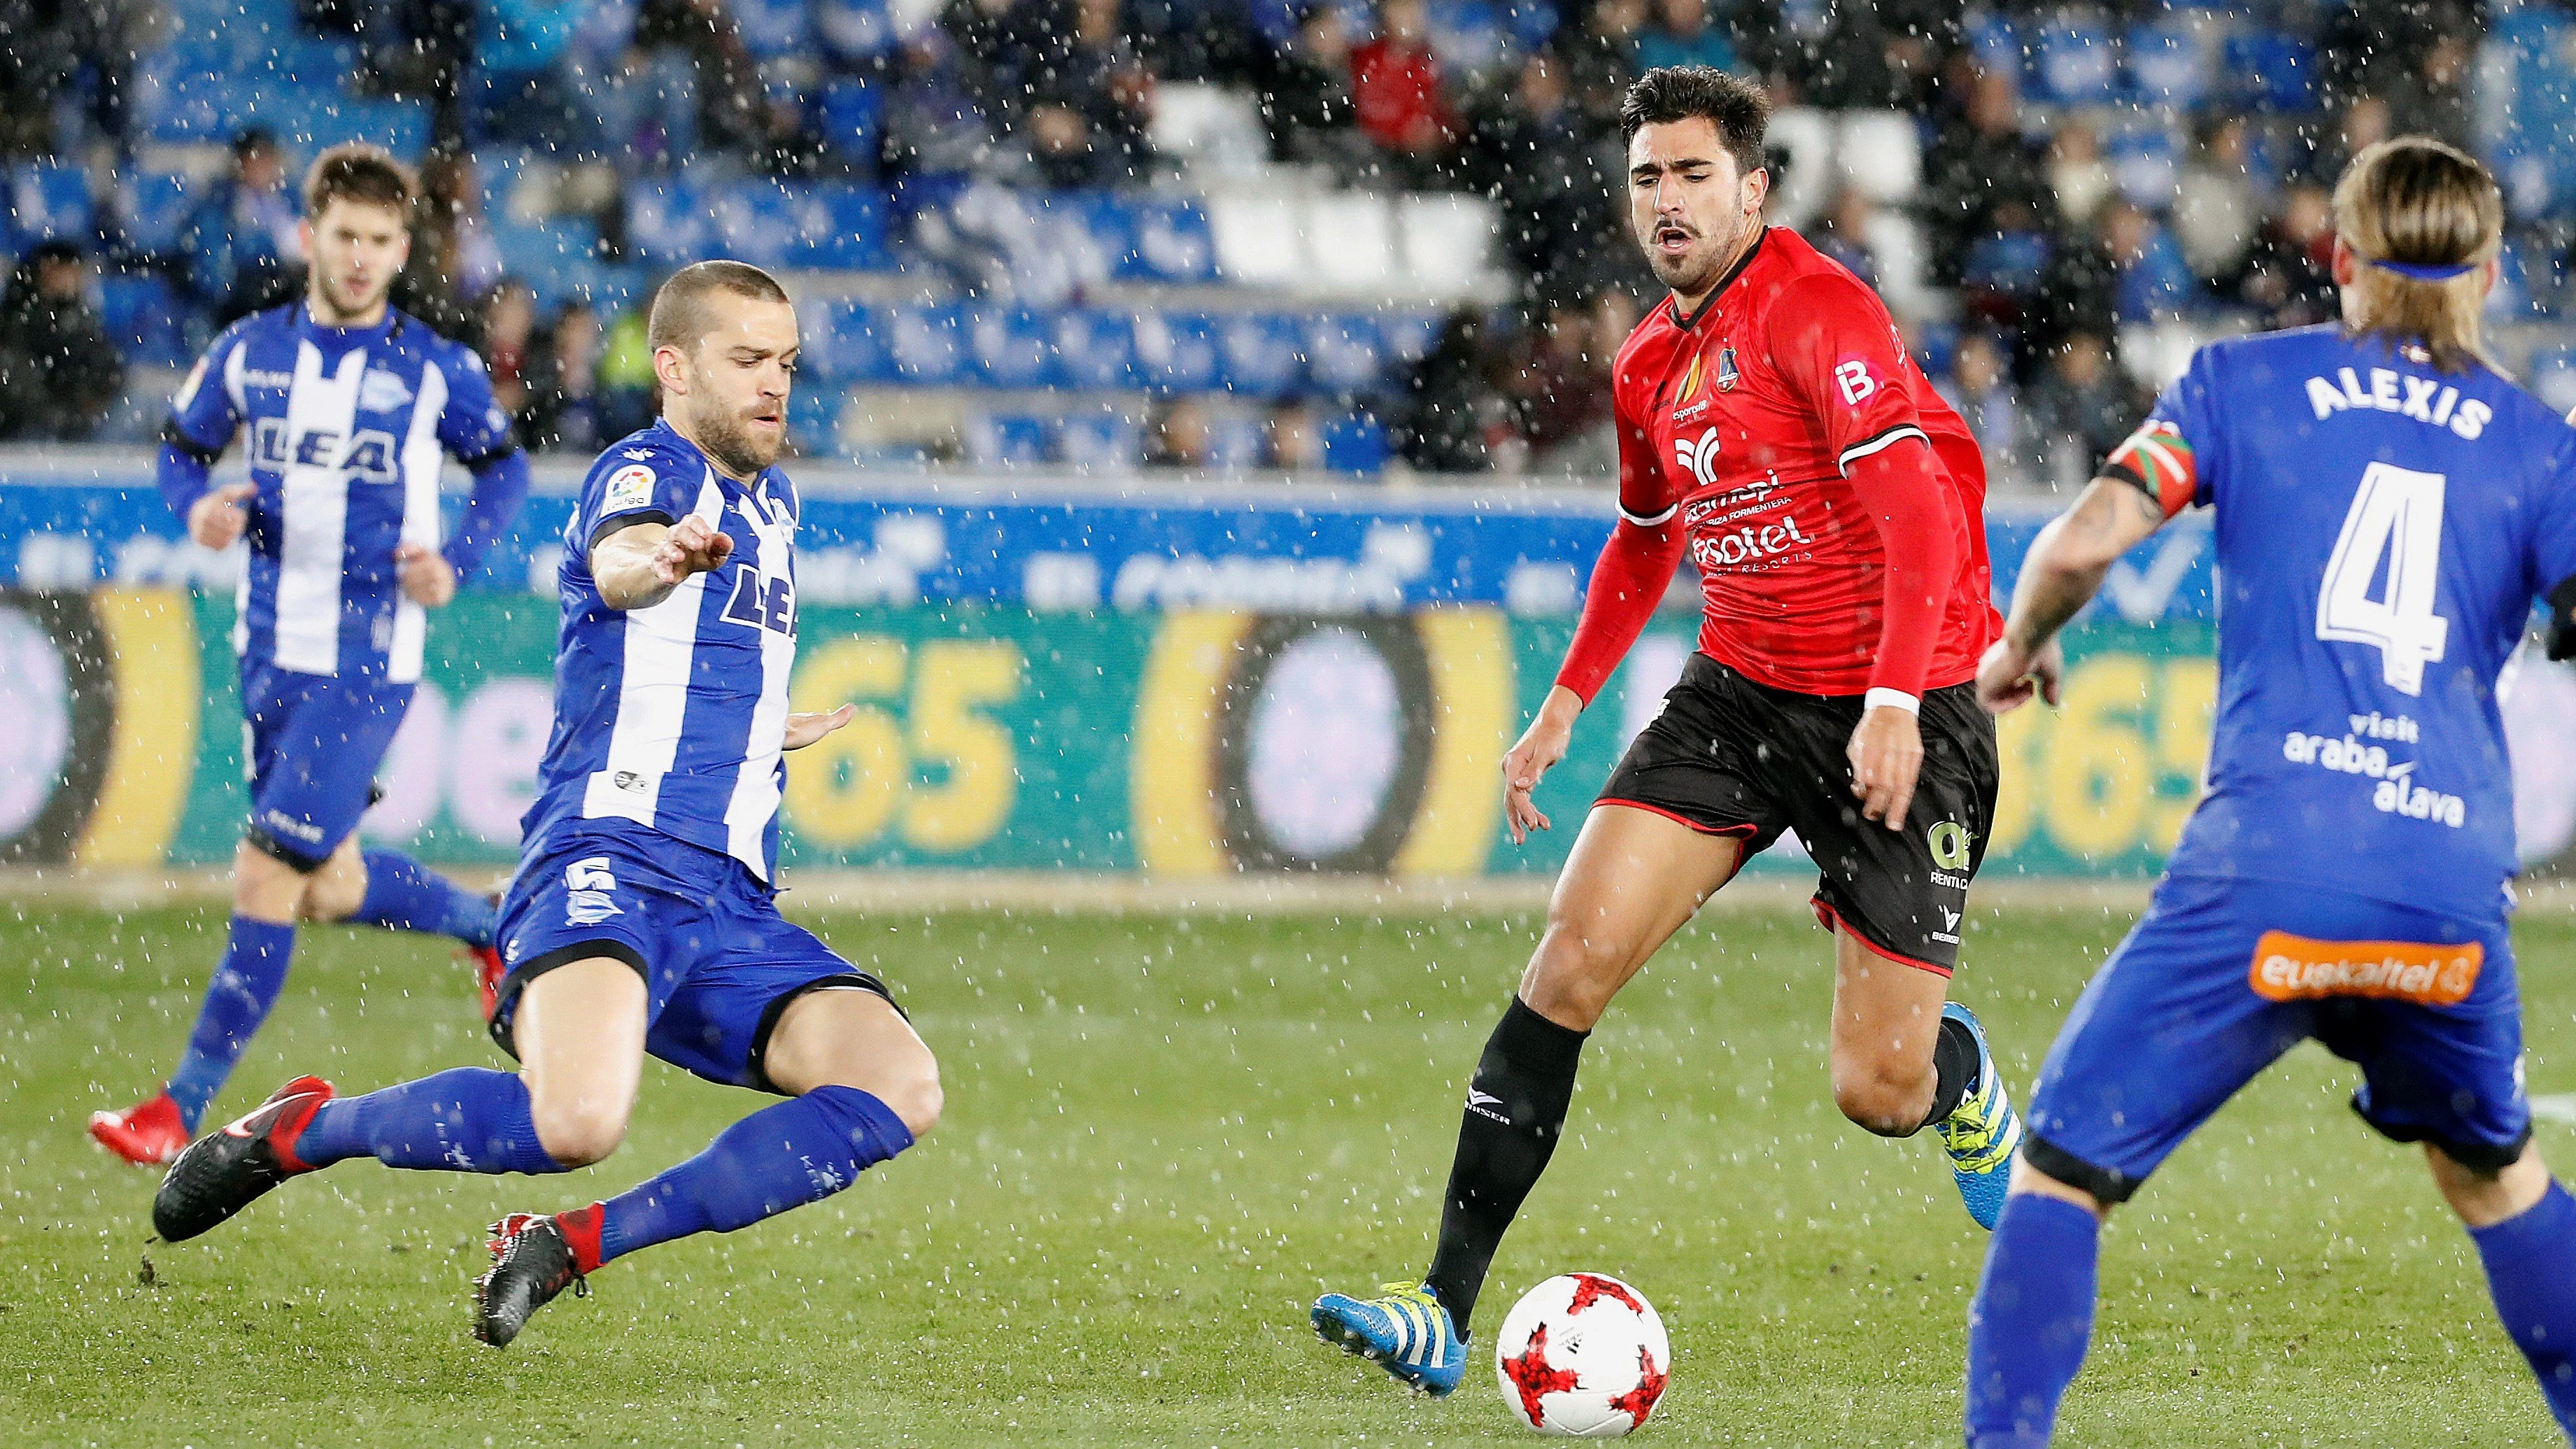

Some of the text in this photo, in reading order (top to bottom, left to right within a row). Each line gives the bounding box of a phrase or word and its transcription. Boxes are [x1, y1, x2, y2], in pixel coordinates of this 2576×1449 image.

[2305, 367, 2493, 441] ALEXIS
[255, 416, 398, 484] LEA
[1729, 497, 1792, 521] FORMENTERA
[1741, 551, 1812, 573] RESORTS
[2315, 460, 2448, 696] 4
[2349, 711, 2420, 744] visit
[2283, 731, 2389, 779] araba
[2260, 953, 2441, 995] euskaltel
